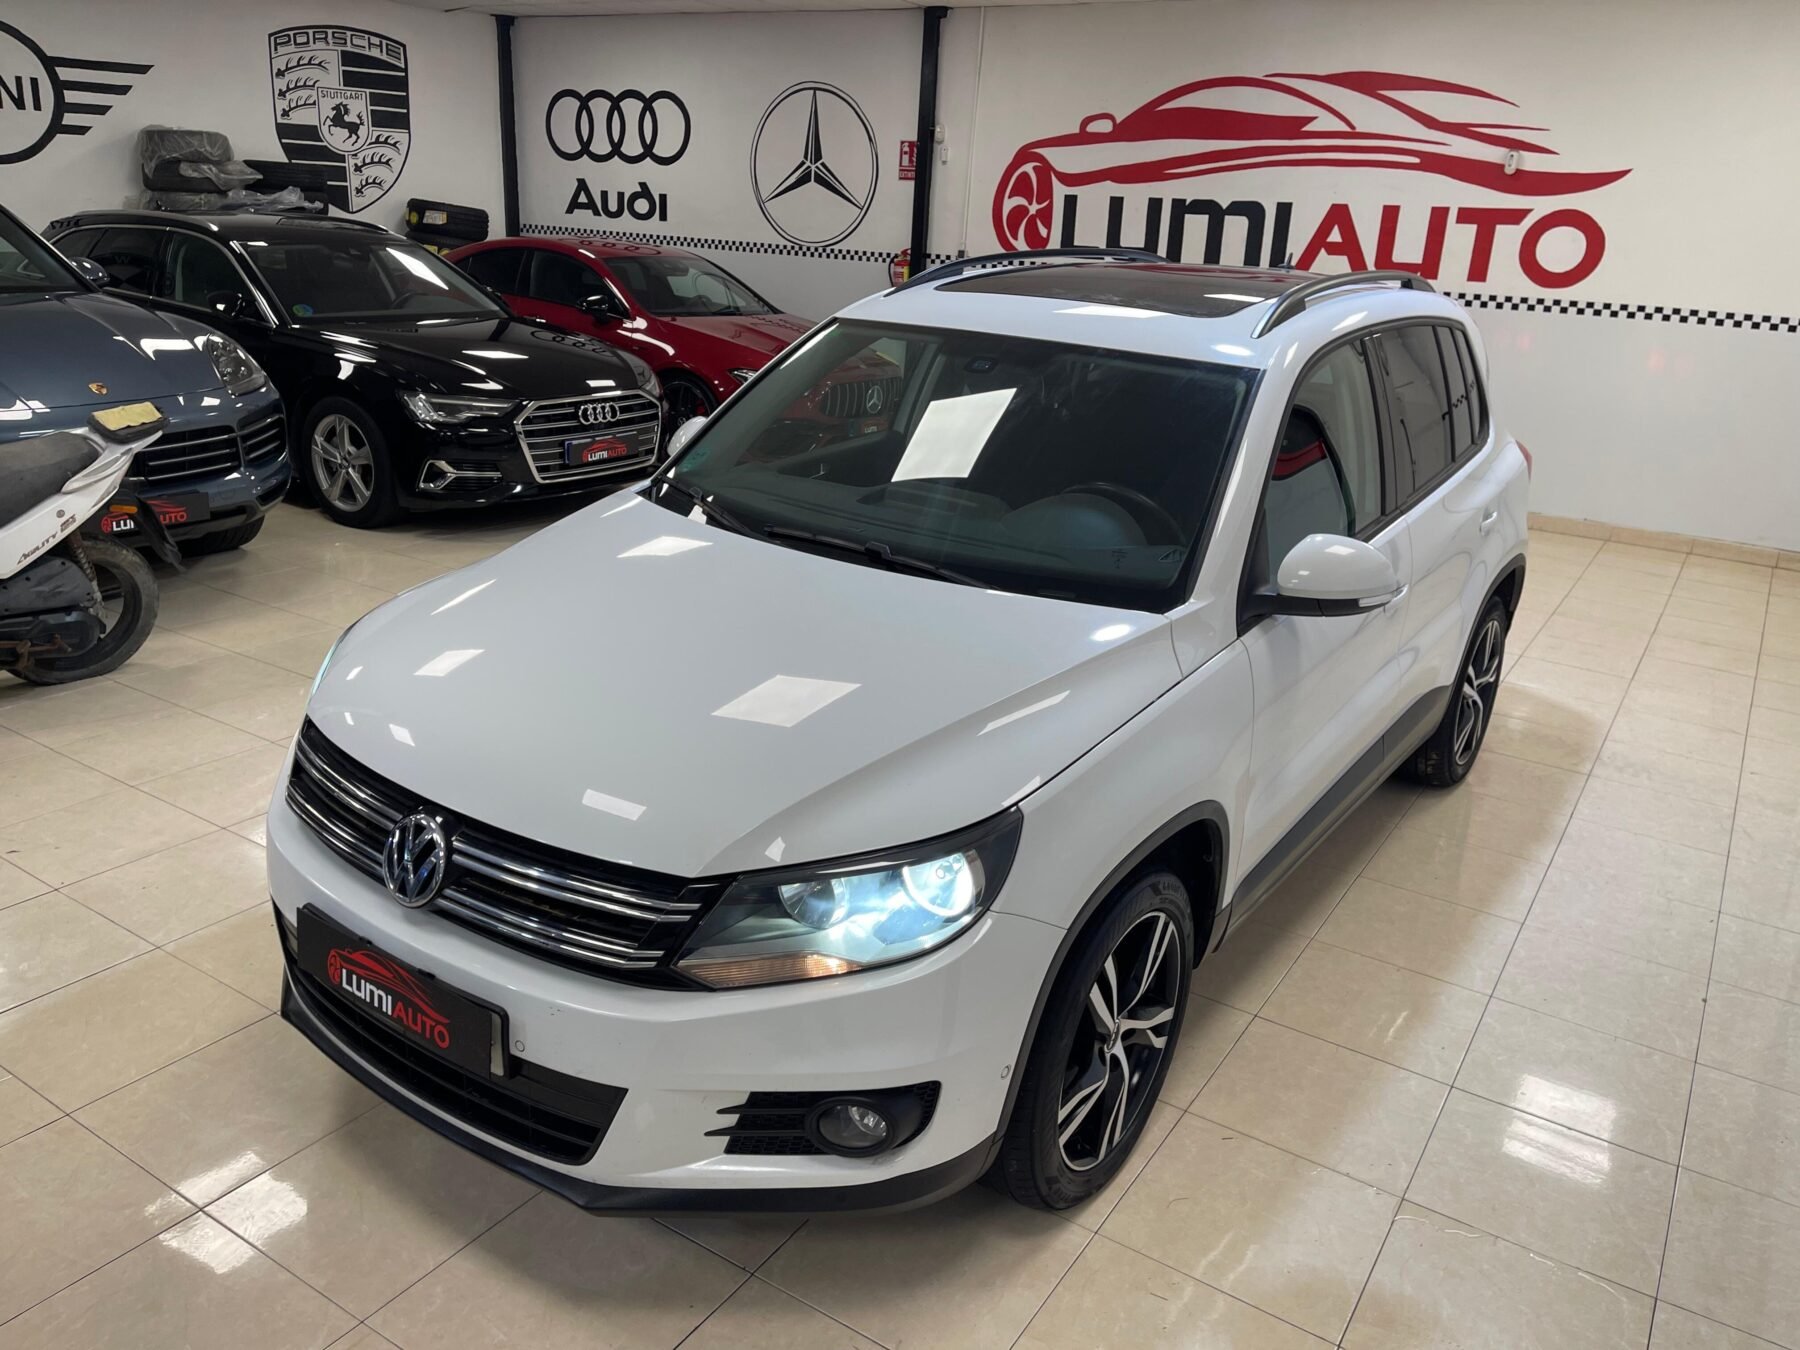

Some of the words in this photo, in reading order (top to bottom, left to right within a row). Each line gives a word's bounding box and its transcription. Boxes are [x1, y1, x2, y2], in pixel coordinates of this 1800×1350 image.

[273, 30, 402, 62] PORSCHE
[320, 90, 364, 100] STUTTGART
[565, 178, 667, 221] Audi
